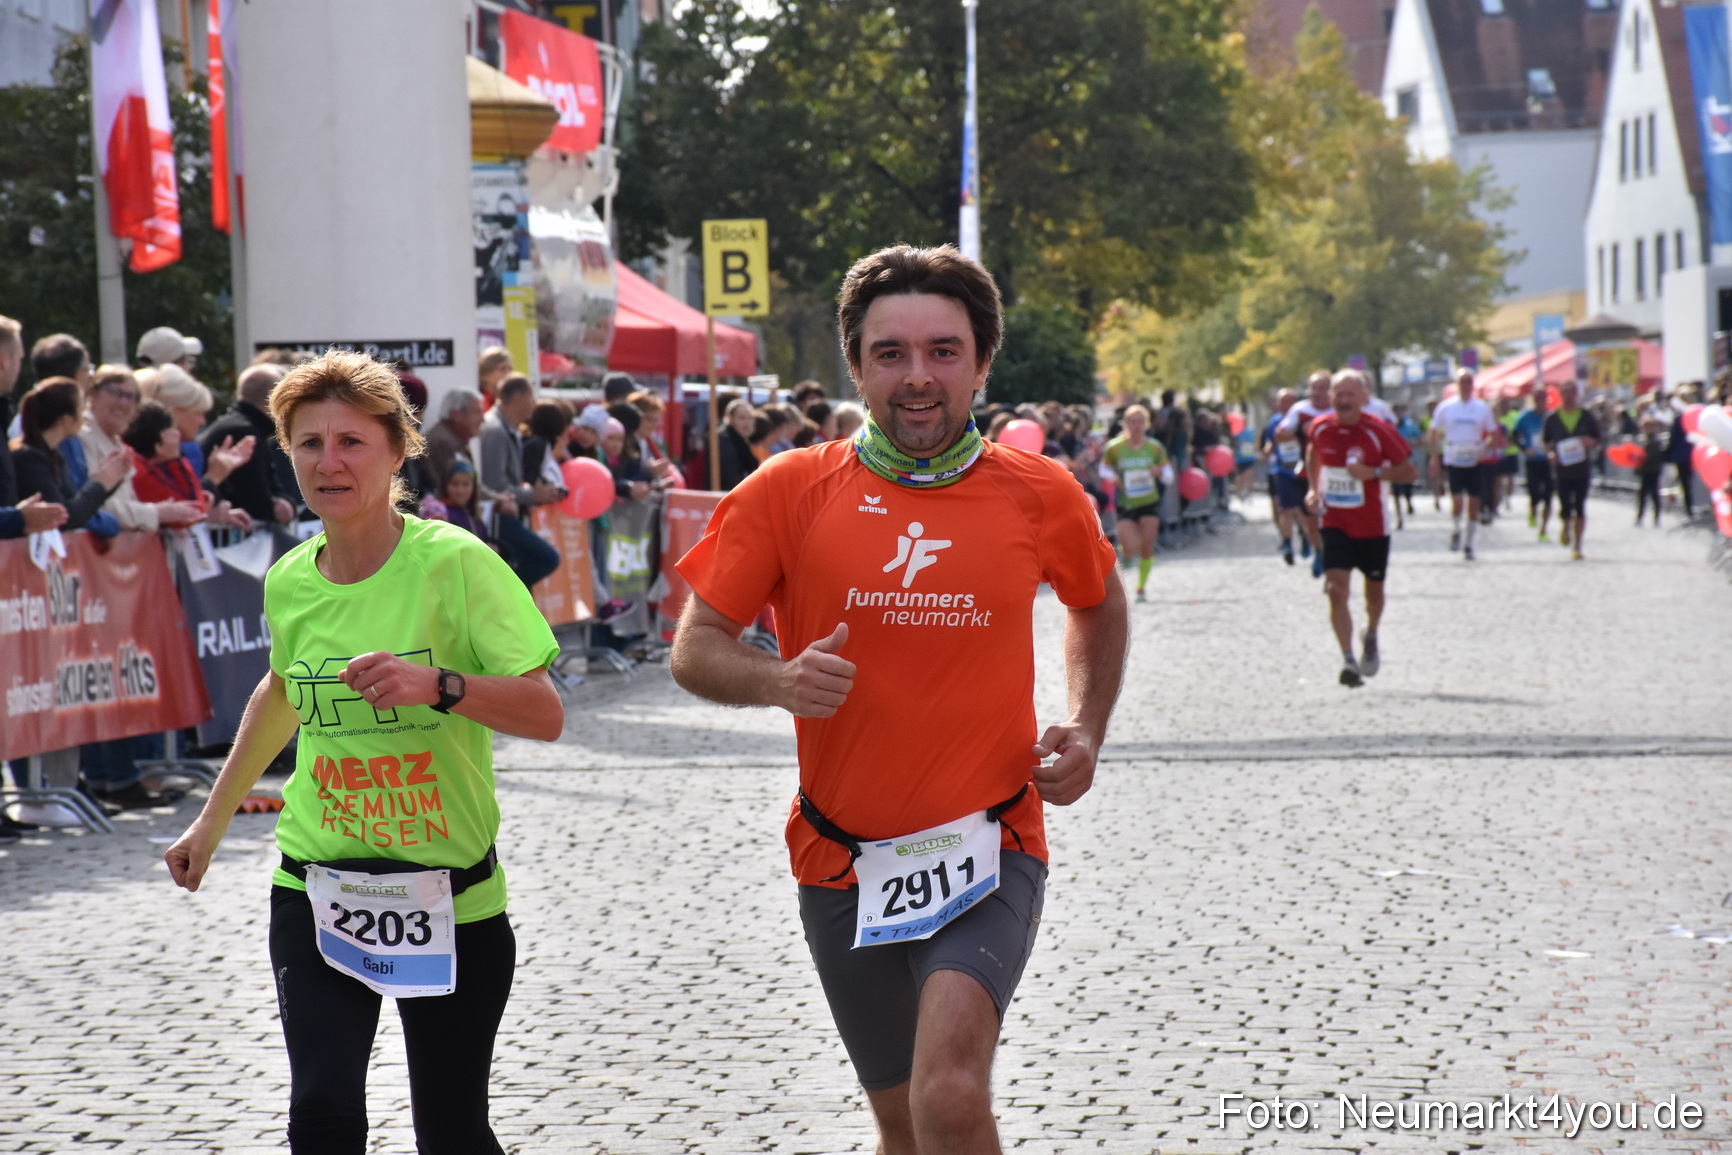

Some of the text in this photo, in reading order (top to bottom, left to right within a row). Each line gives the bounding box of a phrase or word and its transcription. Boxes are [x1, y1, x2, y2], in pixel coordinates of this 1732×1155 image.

[711, 224, 759, 242] Block
[721, 250, 752, 294] B
[1141, 348, 1158, 376] C
[858, 505, 888, 515] erima
[844, 587, 975, 611] funrunners
[882, 608, 993, 627] neumarkt
[312, 750, 438, 791] MERZ
[881, 856, 975, 918] 2911
[330, 902, 432, 947] 2203
[891, 892, 975, 938] THOMAS
[363, 956, 394, 975] Gabi
